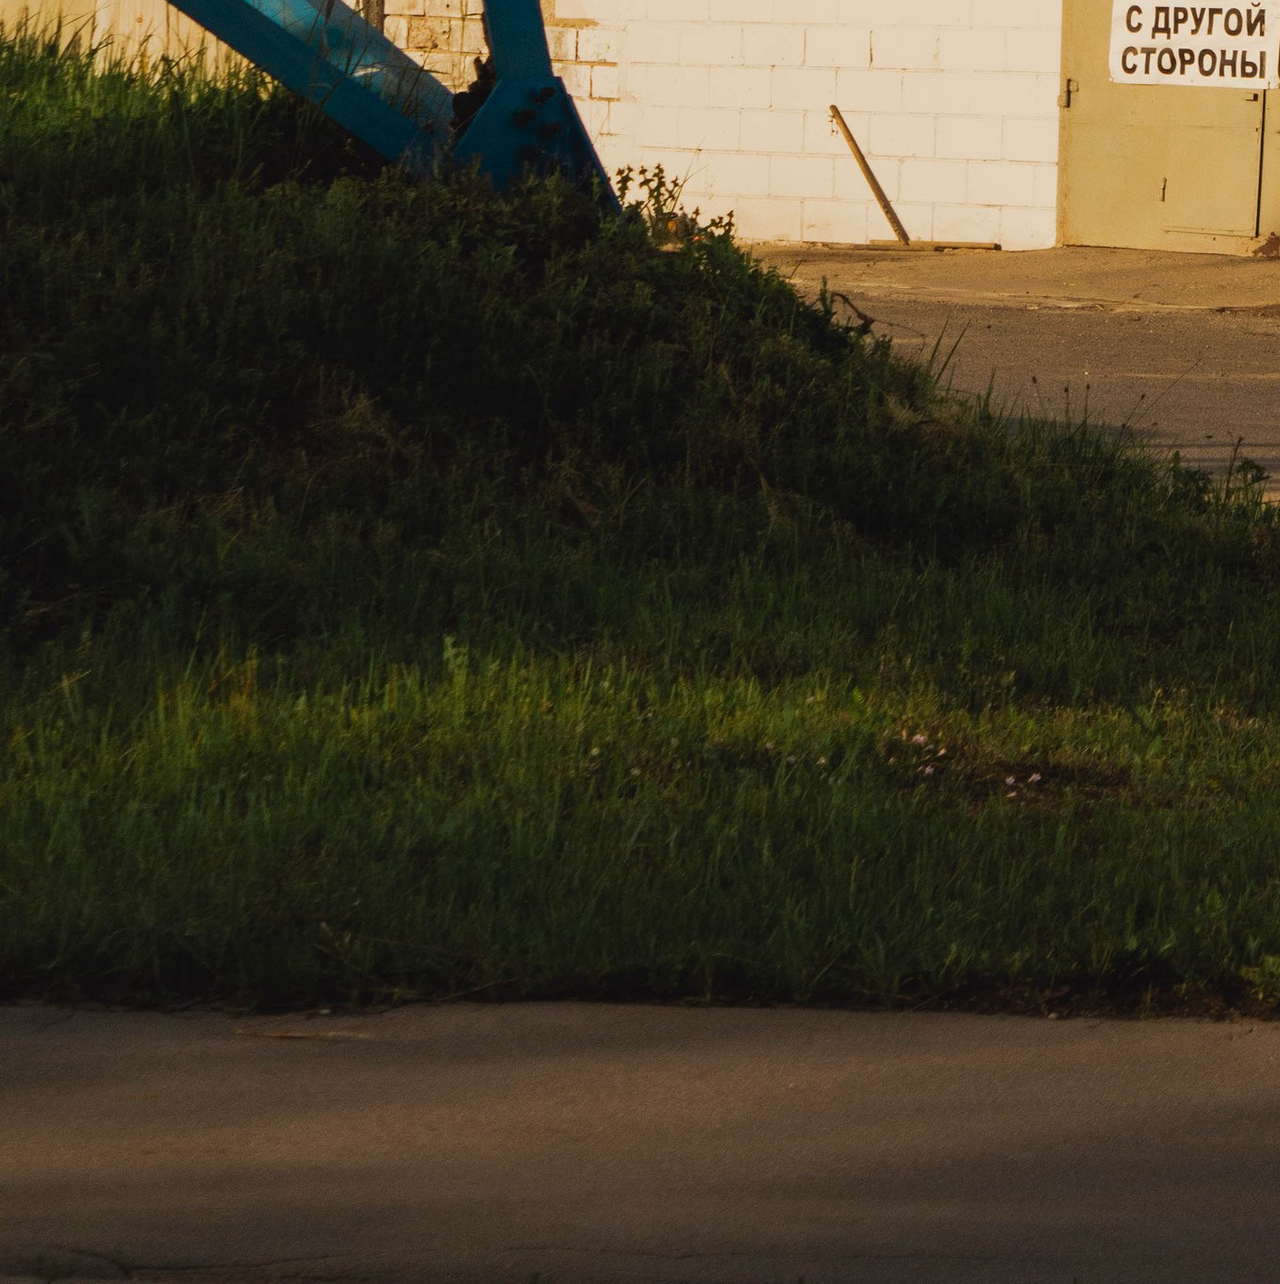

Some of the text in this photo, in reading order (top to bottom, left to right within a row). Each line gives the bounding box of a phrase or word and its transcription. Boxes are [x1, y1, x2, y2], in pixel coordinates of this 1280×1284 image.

[1125, 1, 1267, 40] С ДРУГОЙ
[1120, 45, 1267, 80] СТОРОНЫ
